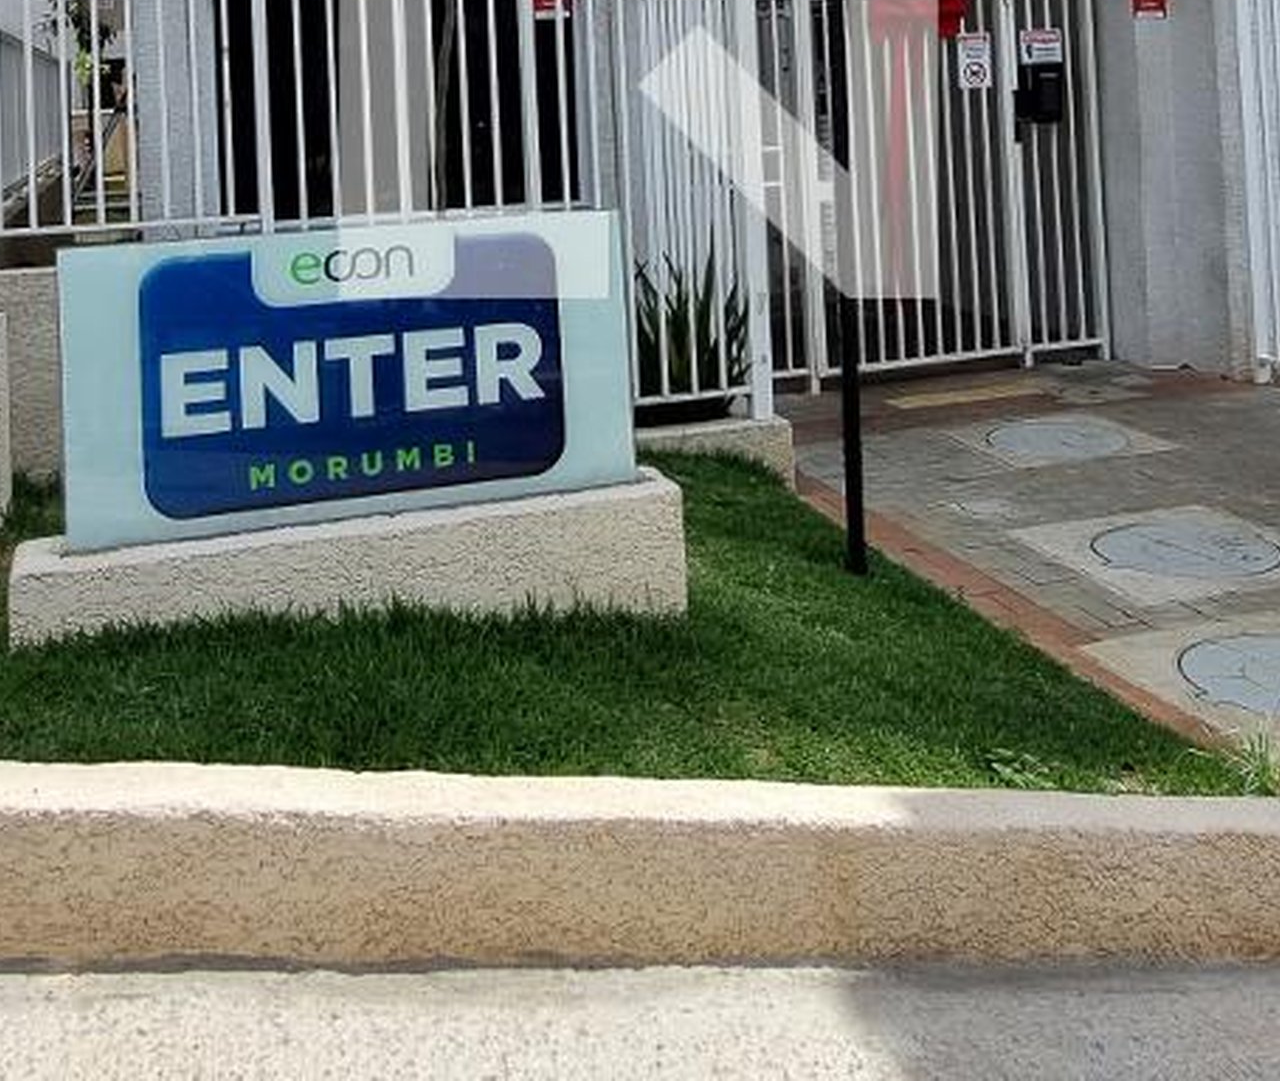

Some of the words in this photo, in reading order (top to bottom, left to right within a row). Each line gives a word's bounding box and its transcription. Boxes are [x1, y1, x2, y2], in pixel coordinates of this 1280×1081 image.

[290, 244, 415, 286] econ
[159, 321, 546, 440] ENTER
[248, 440, 479, 492] MORUMBI
